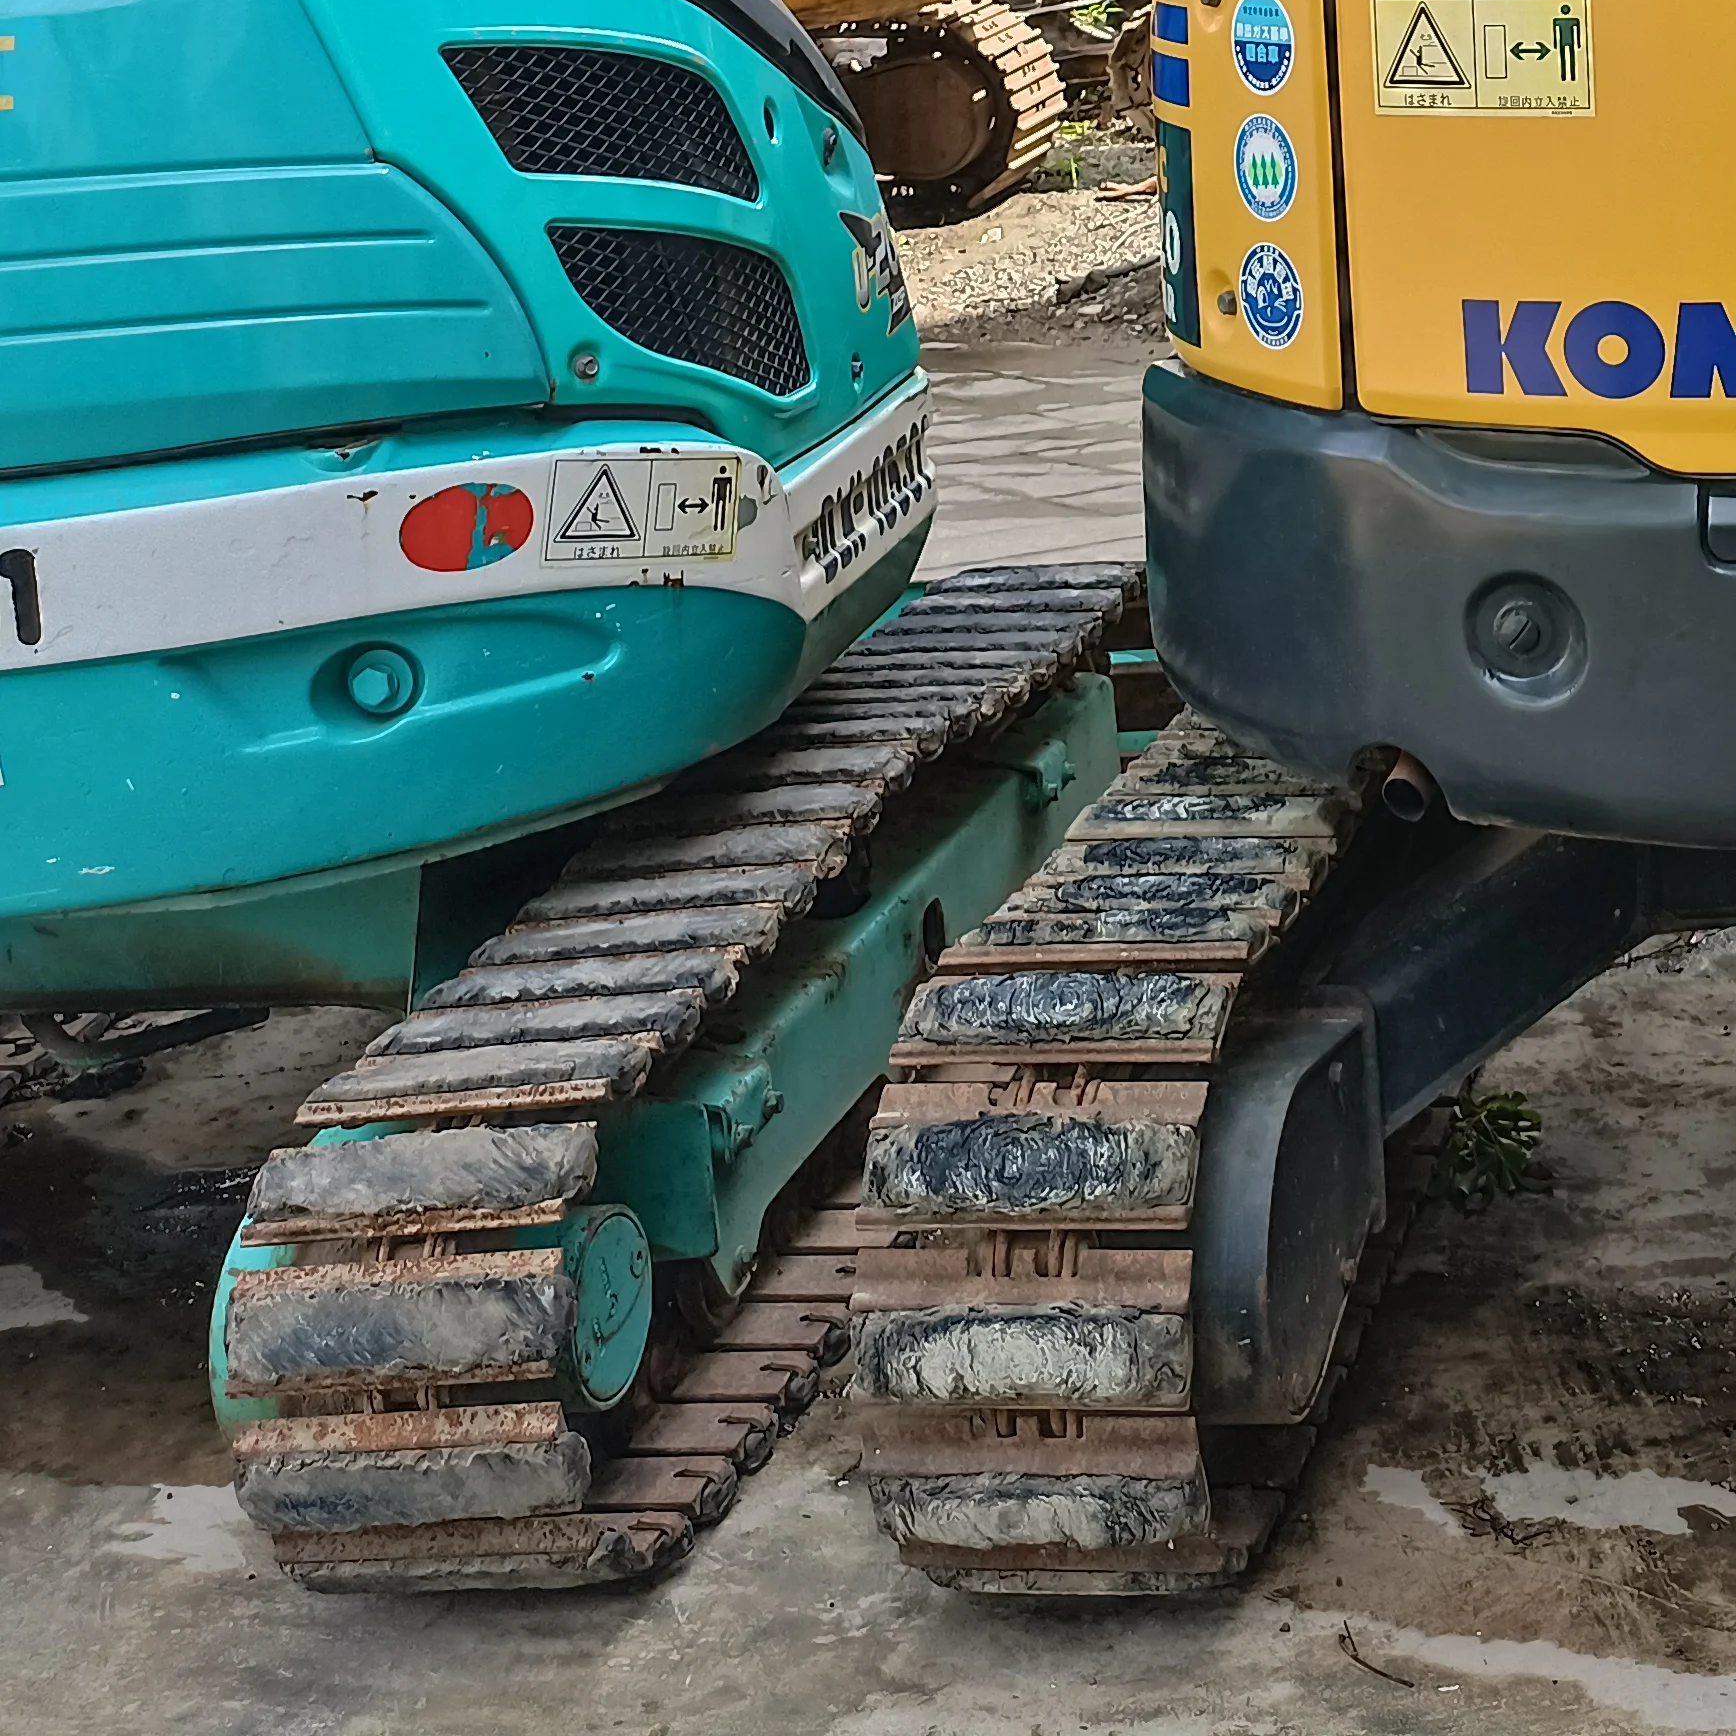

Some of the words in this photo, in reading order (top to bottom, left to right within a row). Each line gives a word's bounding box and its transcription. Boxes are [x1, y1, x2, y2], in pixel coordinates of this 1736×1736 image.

[1404, 93, 1452, 106] はさまれ
[574, 545, 620, 558] はさまれ
